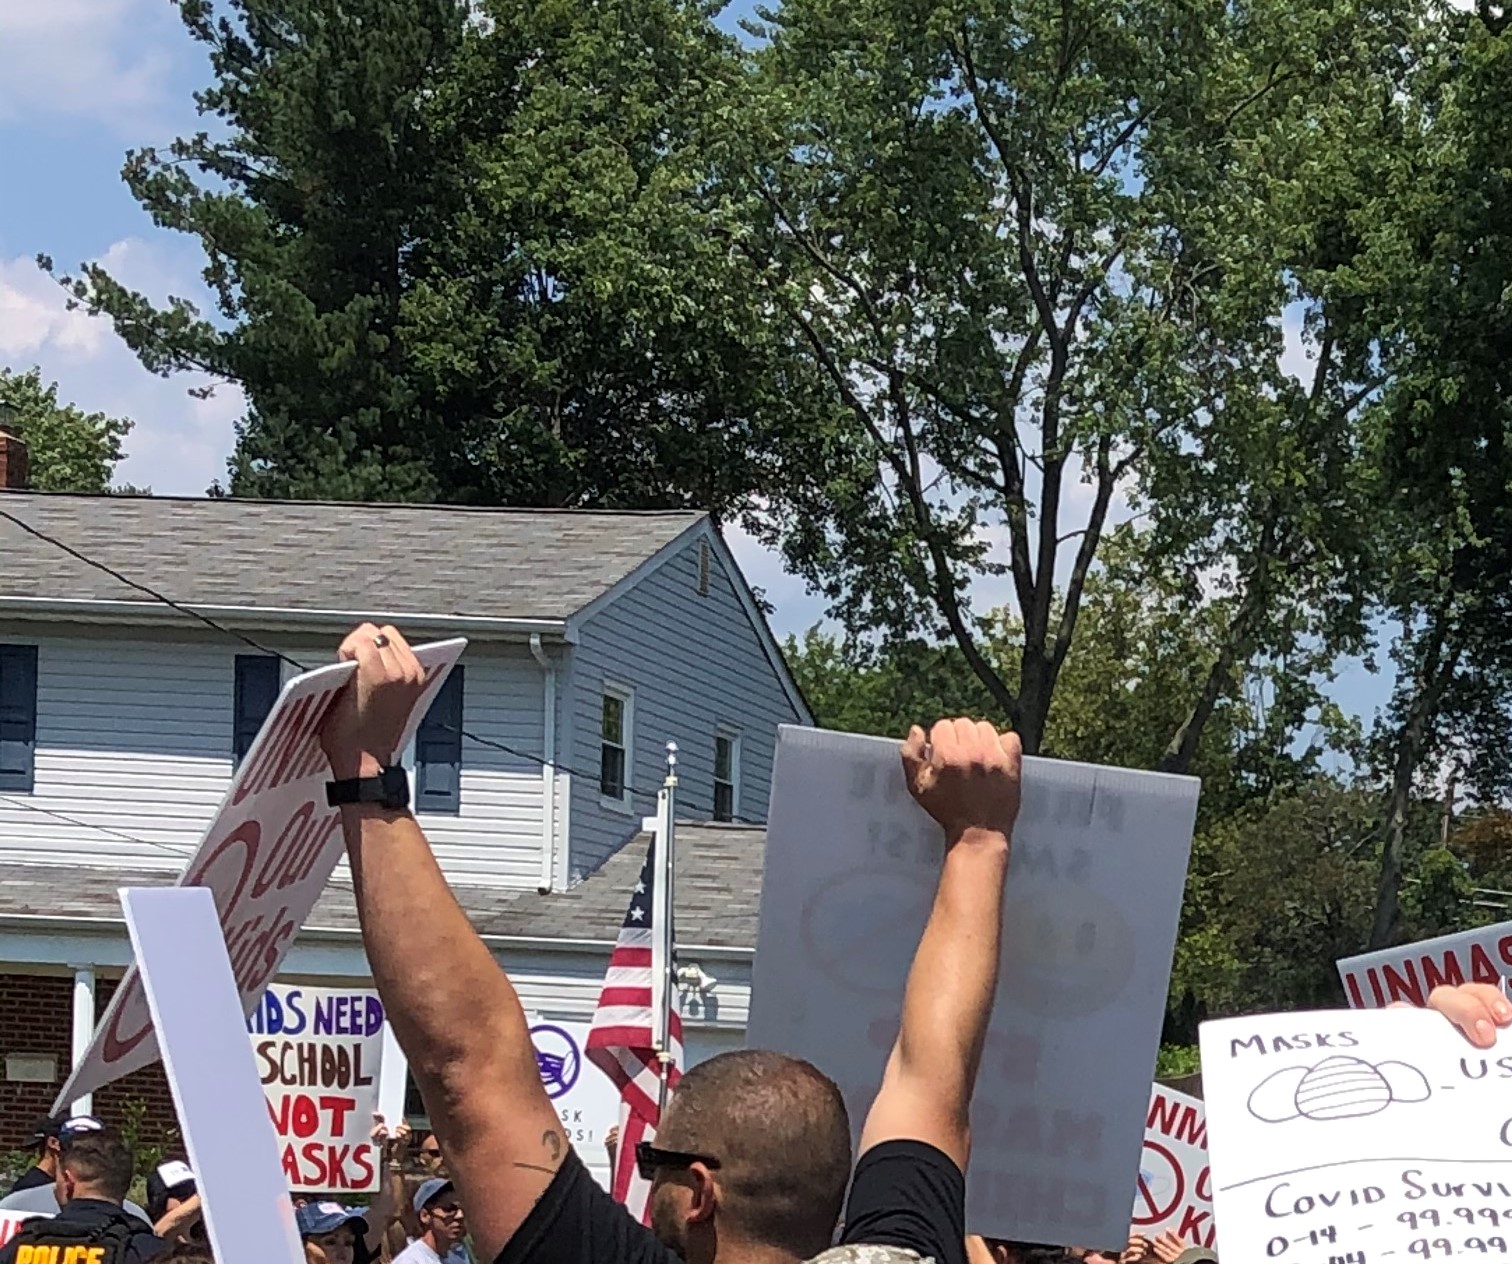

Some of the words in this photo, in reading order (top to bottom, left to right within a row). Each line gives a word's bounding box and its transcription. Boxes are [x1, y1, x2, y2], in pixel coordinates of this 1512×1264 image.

[313, 996, 384, 1037] NEED
[257, 1041, 373, 1089] SCHOOL
[1229, 1031, 1360, 1058] MASKS
